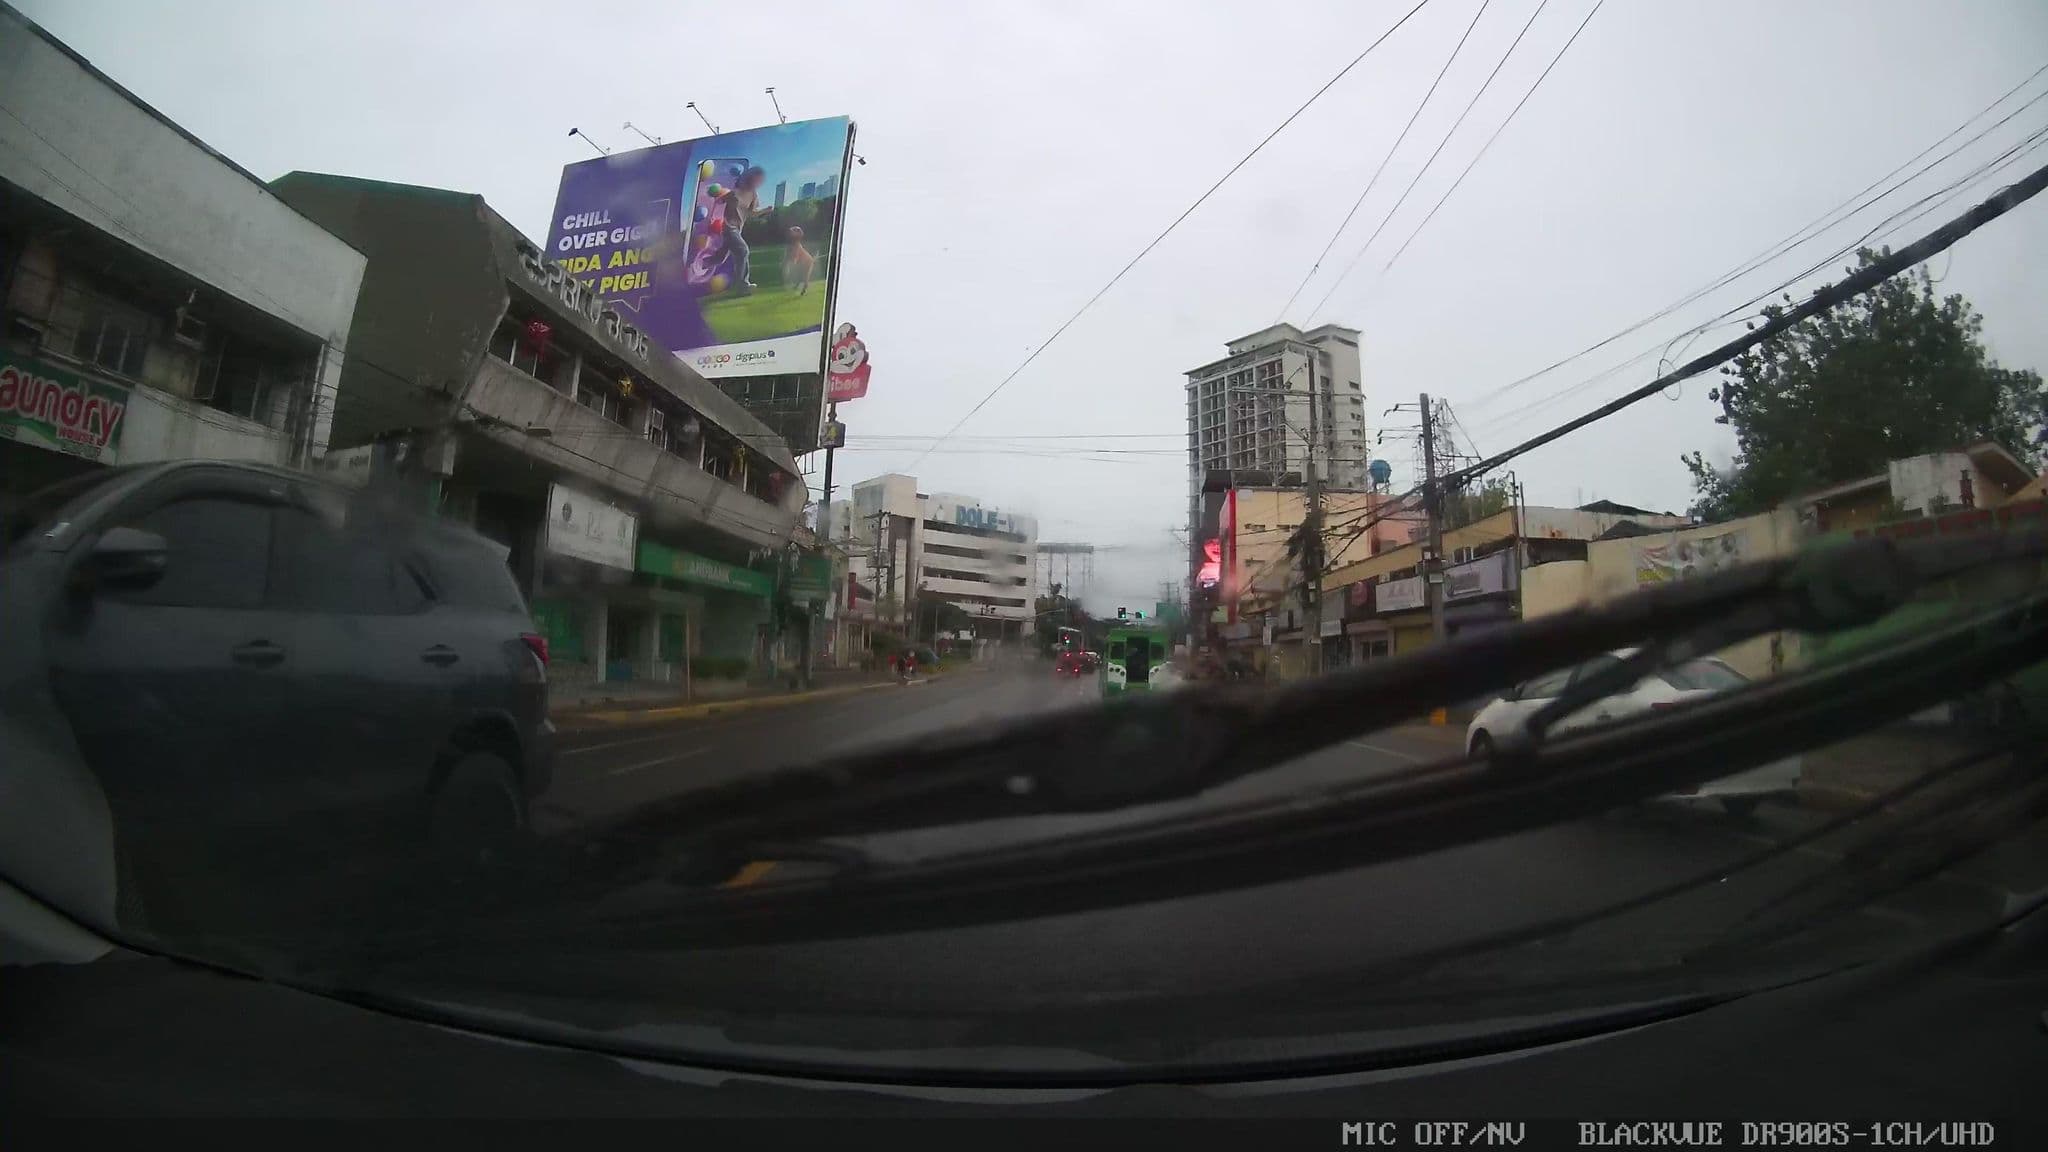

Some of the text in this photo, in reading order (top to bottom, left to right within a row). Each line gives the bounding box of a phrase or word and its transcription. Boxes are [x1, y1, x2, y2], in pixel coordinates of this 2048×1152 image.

[562, 209, 611, 230] CHILL
[558, 220, 653, 251] OVER GIG
[599, 271, 651, 294] PIGIL
[956, 504, 1018, 532] DOLE-V
